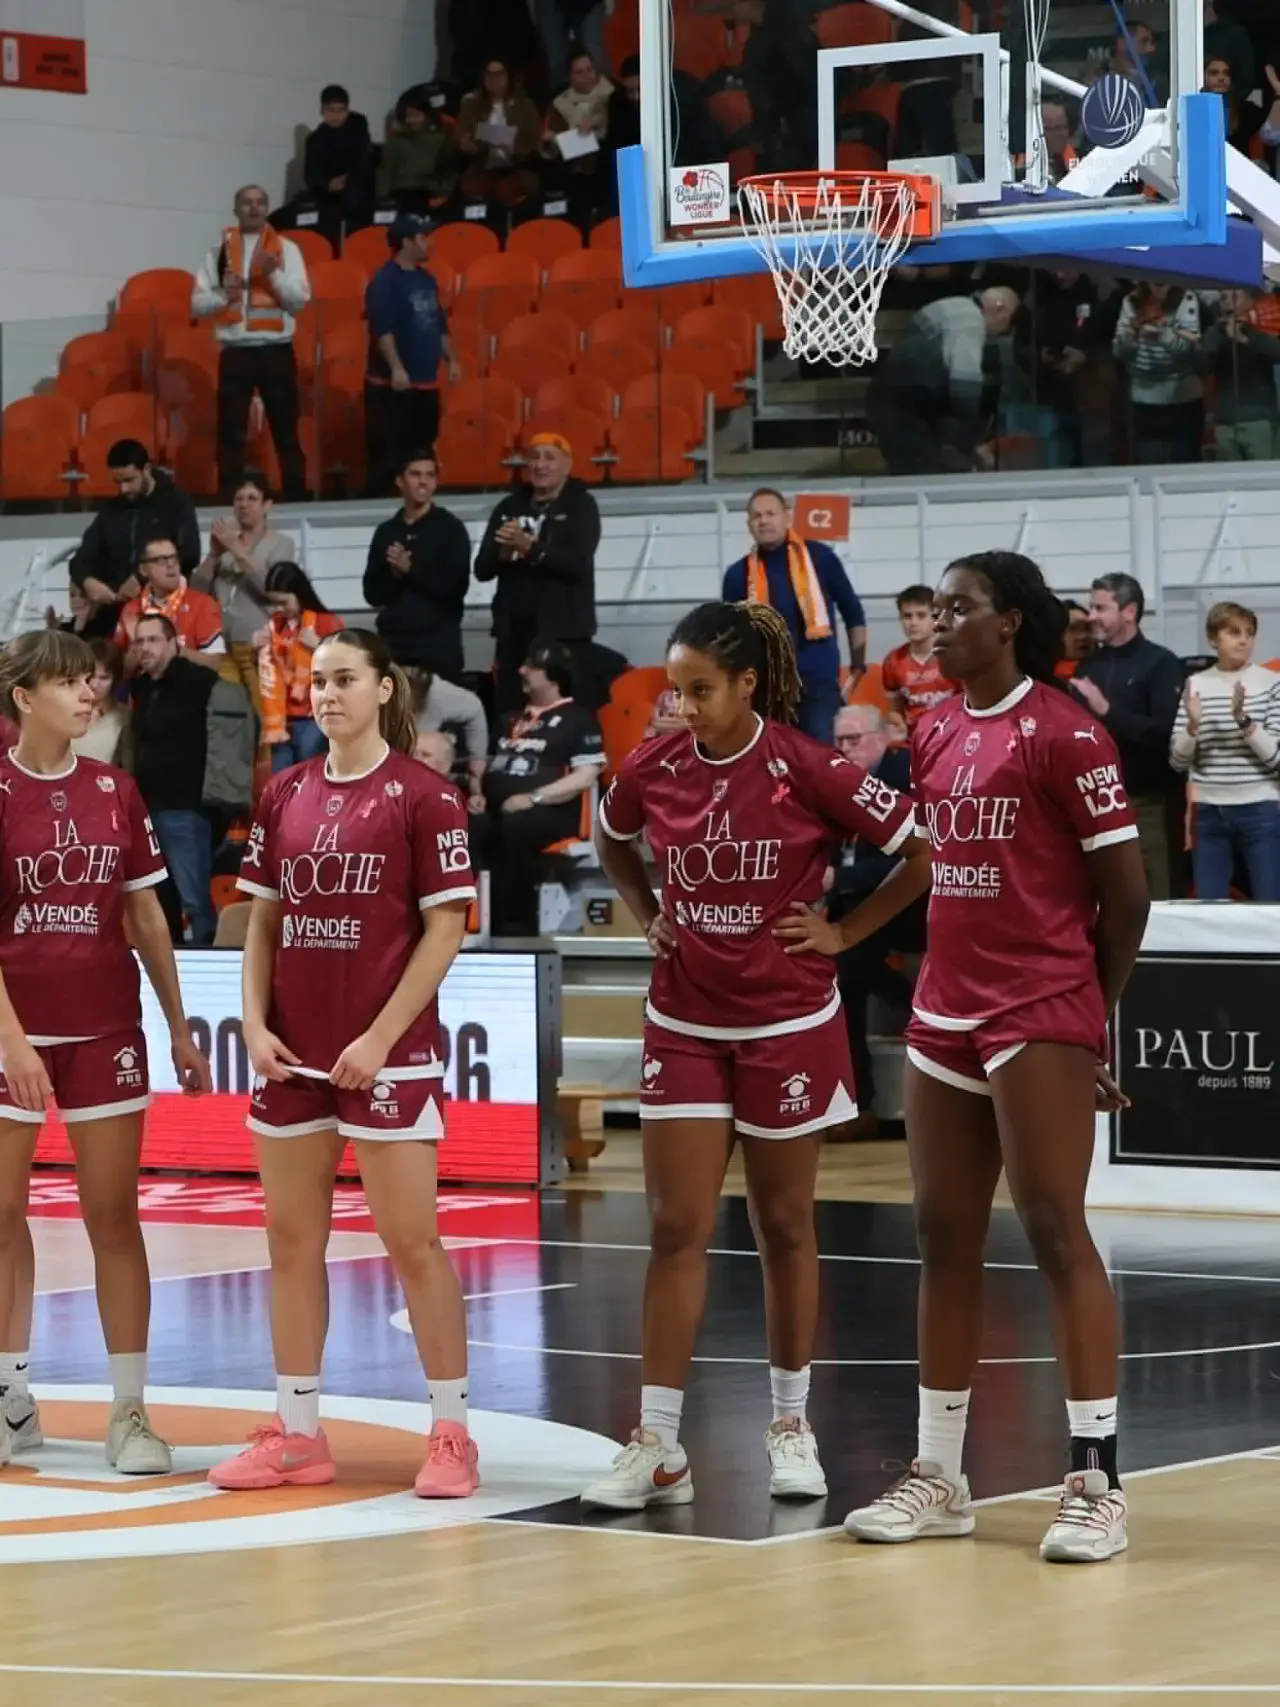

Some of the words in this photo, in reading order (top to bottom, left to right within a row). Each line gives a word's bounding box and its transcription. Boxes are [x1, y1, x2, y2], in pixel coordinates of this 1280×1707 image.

[808, 509, 832, 528] C2
[951, 765, 976, 797] LA
[1075, 763, 1119, 793] NEW
[1083, 783, 1127, 819] LOC
[53, 820, 80, 848] LA
[311, 823, 339, 852] LA
[704, 809, 731, 842] LA
[925, 796, 1020, 852] ROCHE
[15, 845, 119, 895] ROCHE
[439, 847, 470, 874] LO
[667, 839, 782, 892] ROCHE
[936, 861, 1001, 887] VENDÉE
[280, 853, 386, 904] ROCHE
[33, 903, 98, 926] VENDÉE
[294, 915, 361, 938] VENDÉE
[689, 901, 763, 924] VENDÉE
[32, 924, 42, 934] LE
[1135, 1028, 1274, 1072] PAUL
[116, 1075, 142, 1086] PRB
[1198, 1074, 1238, 1090] depuis
[1243, 1074, 1271, 1089] 1889
[779, 1101, 811, 1114] PRB
